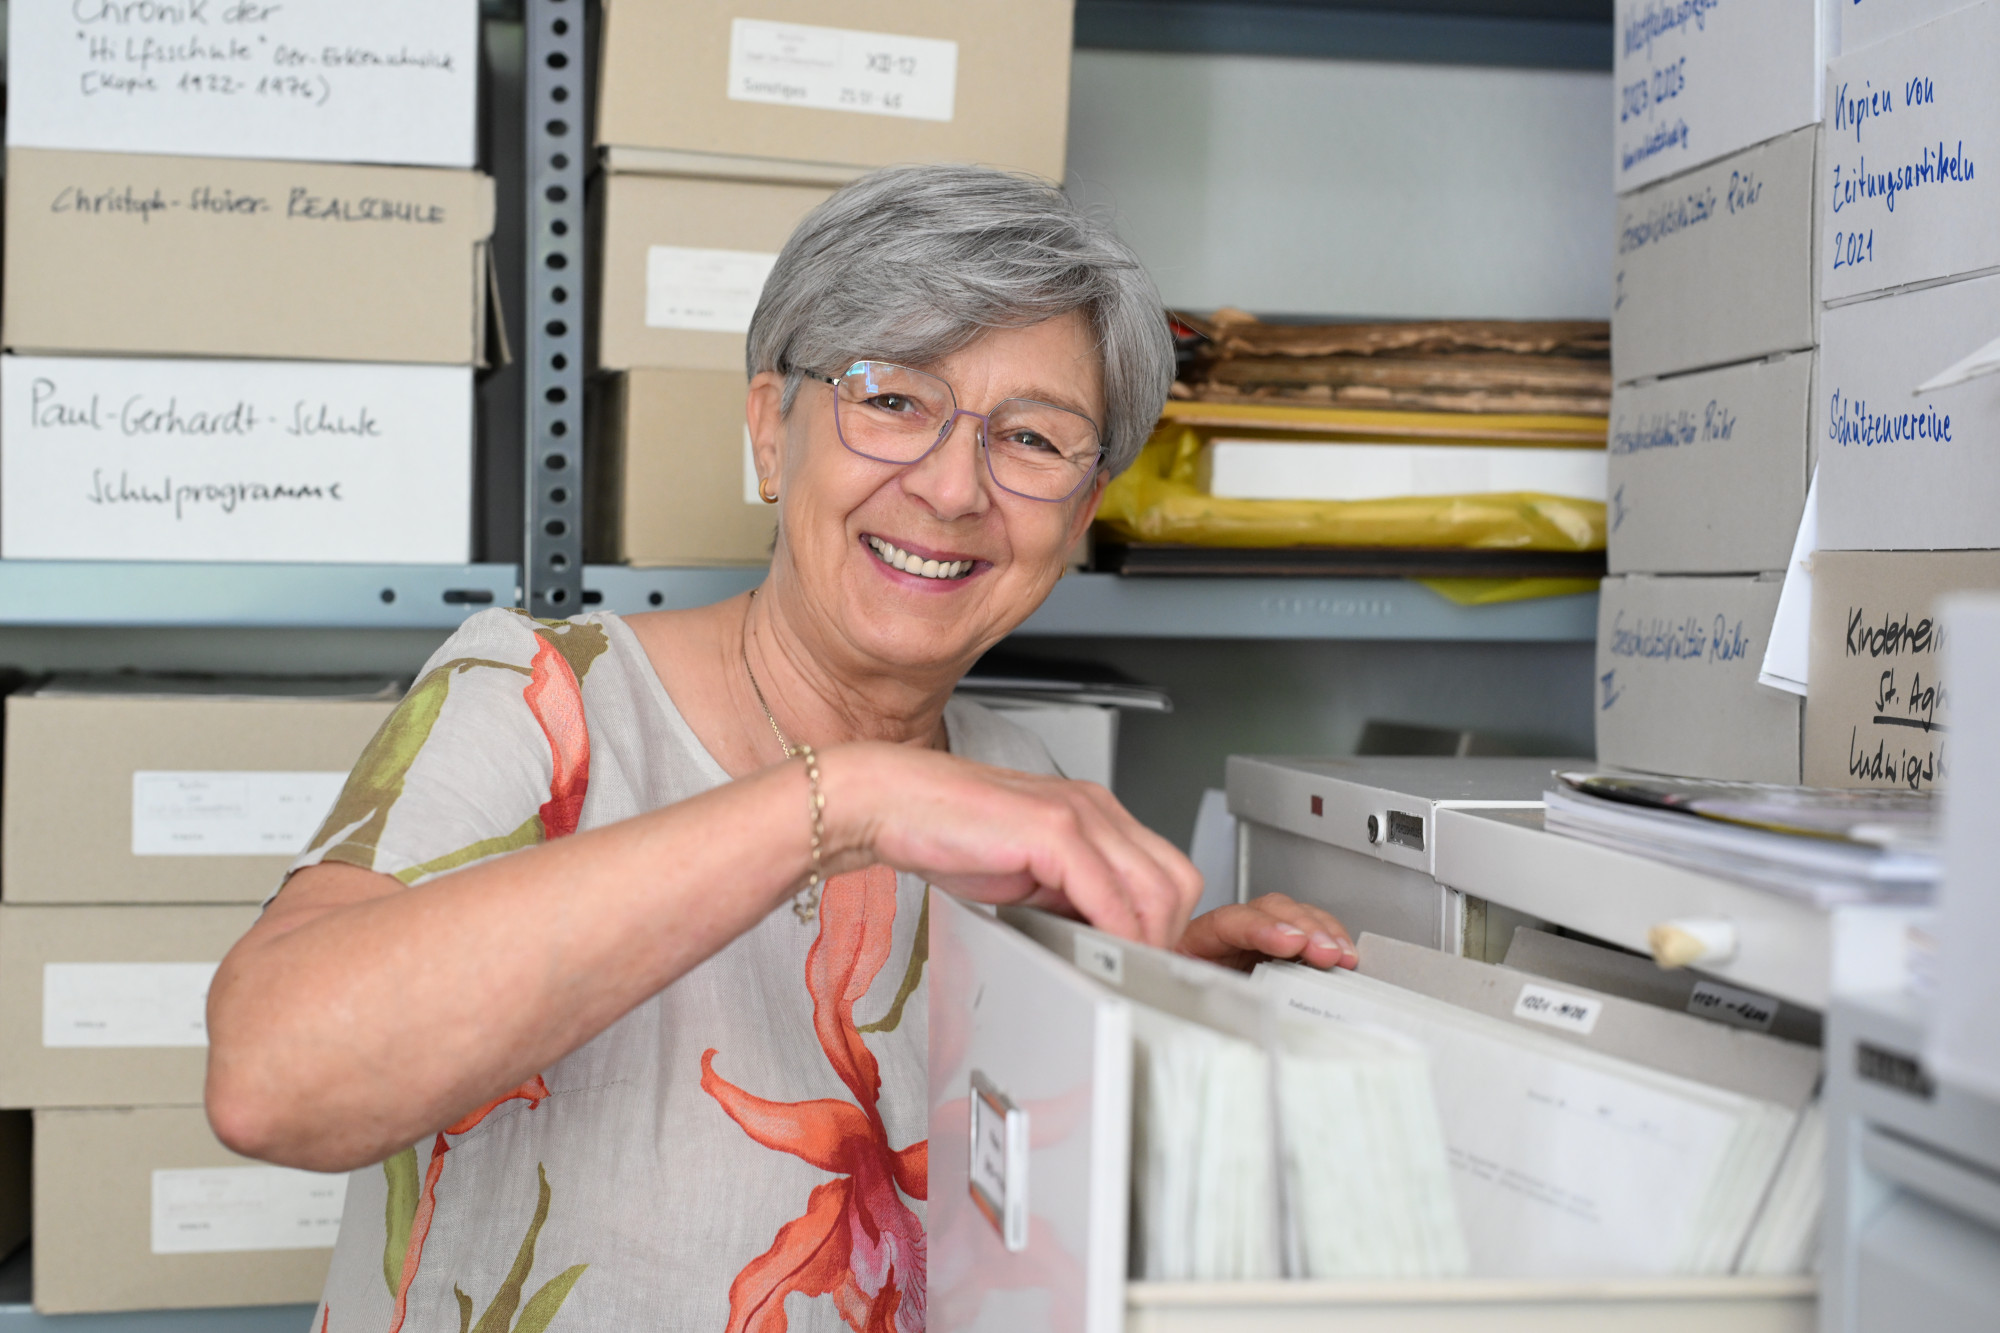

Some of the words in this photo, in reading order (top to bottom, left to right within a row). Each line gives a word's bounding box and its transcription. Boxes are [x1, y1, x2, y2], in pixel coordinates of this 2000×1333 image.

[221, 0, 283, 24] der
[1835, 81, 1893, 143] Kopien
[1905, 76, 1934, 106] von
[1833, 140, 1975, 213] Zeitungsartikeln
[1833, 229, 1873, 270] 2021
[1828, 388, 1953, 447] Schützenvereine
[1874, 667, 1900, 713] St.
[1908, 671, 1949, 734] Agn
